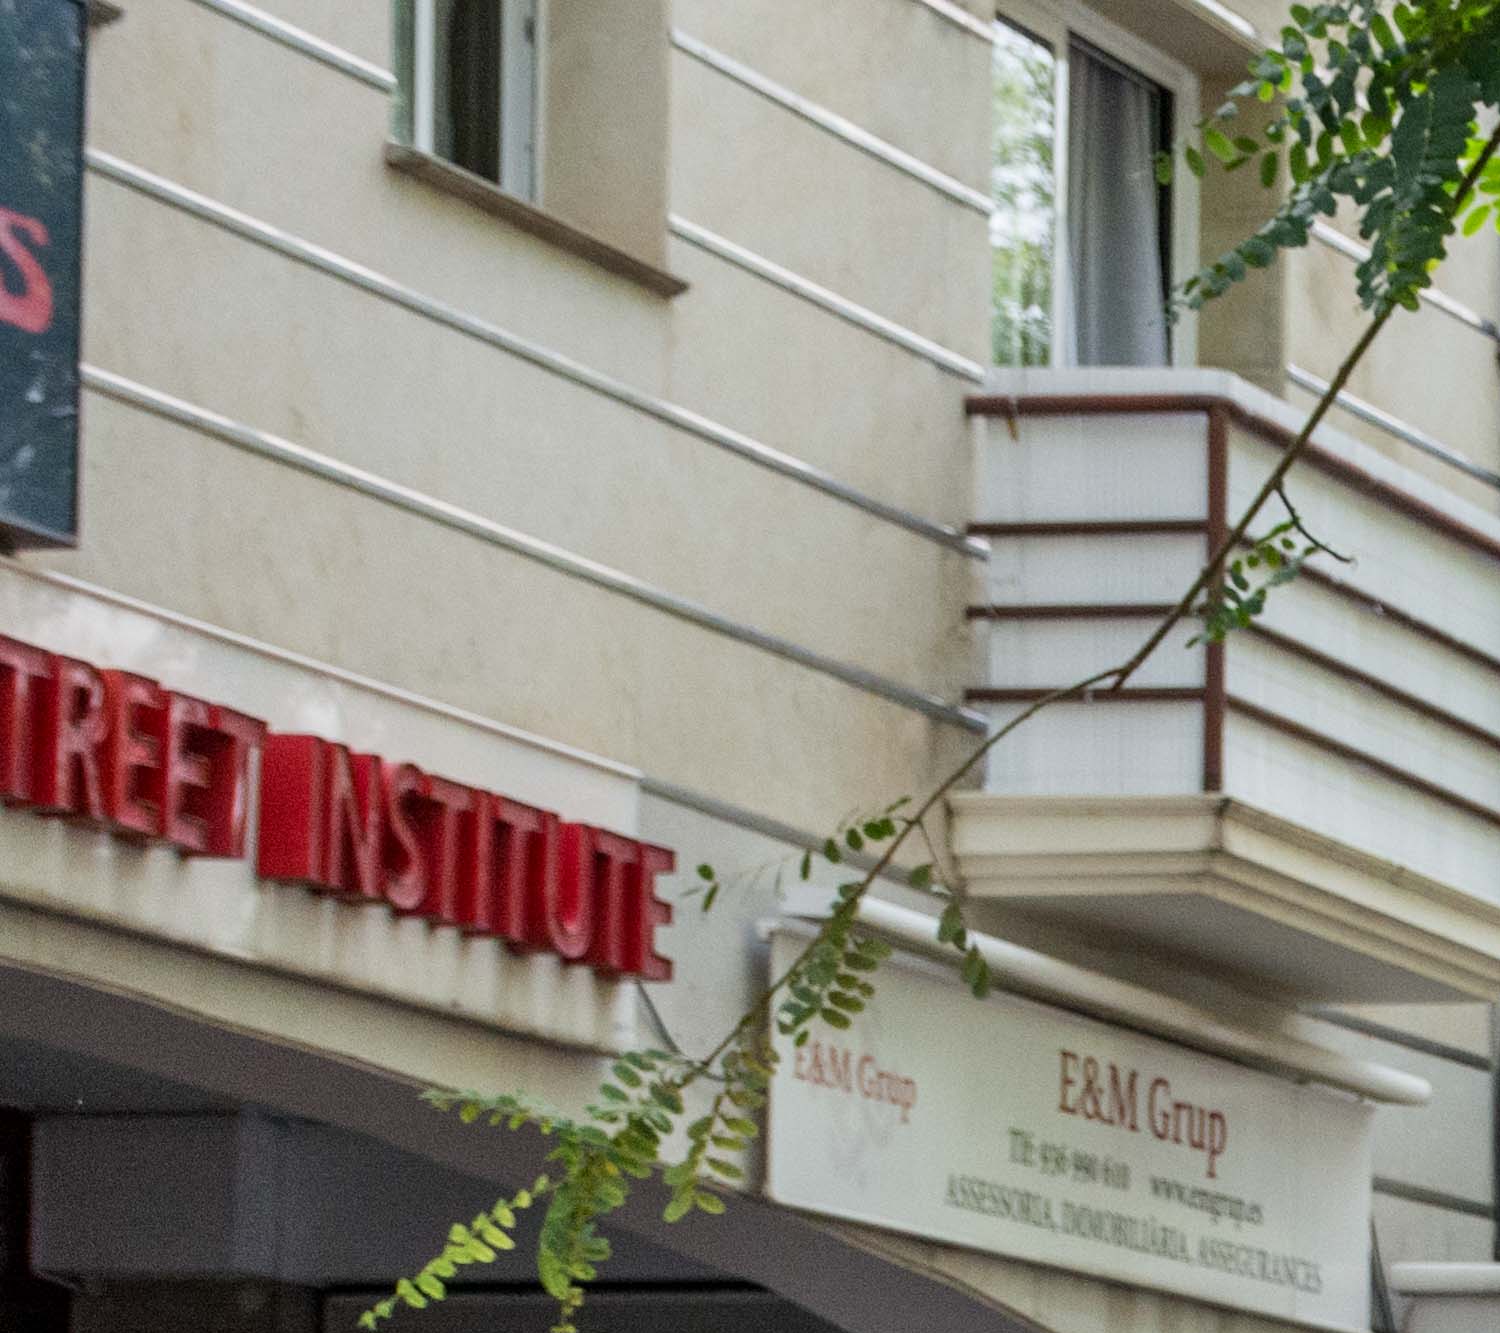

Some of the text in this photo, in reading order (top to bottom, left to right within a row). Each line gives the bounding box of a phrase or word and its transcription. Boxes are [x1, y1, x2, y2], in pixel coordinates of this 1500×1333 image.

[300, 733, 675, 982] INSTITUTE
[856, 1054, 918, 1125] Grup
[1057, 1048, 1228, 1179] E&M Grup
